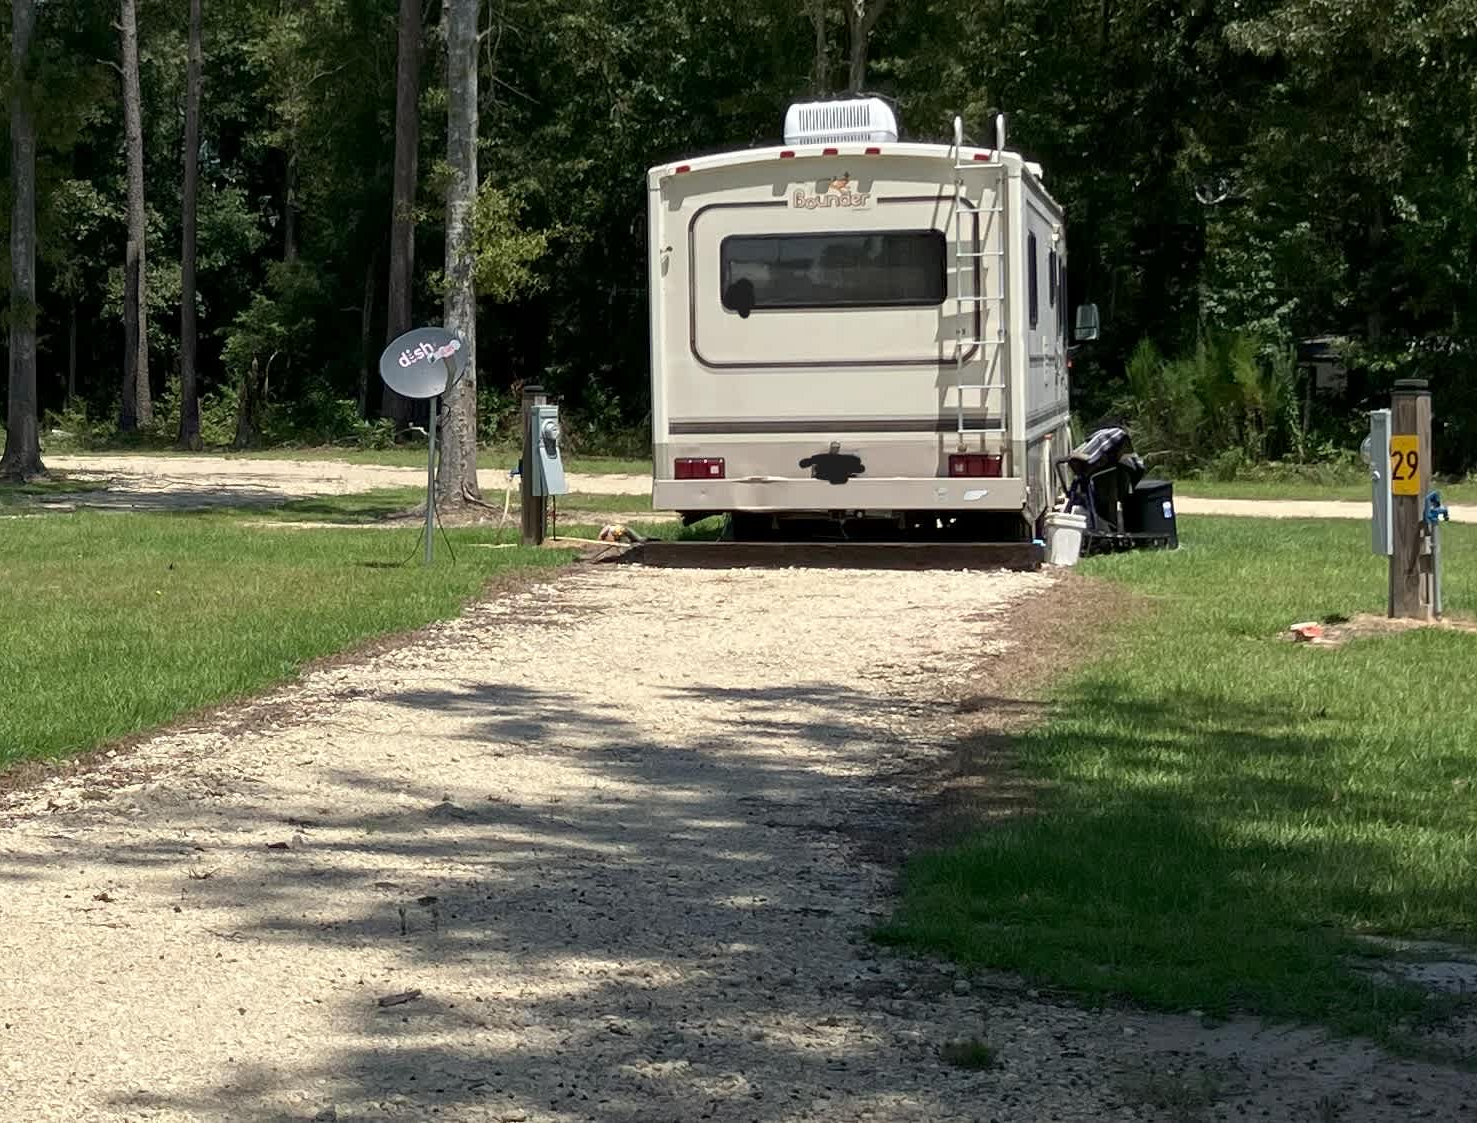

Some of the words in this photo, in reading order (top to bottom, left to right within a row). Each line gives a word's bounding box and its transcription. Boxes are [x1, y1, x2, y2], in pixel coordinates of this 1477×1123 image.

[793, 188, 870, 210] Bounder
[398, 342, 434, 367] dish
[1391, 450, 1418, 481] 29
